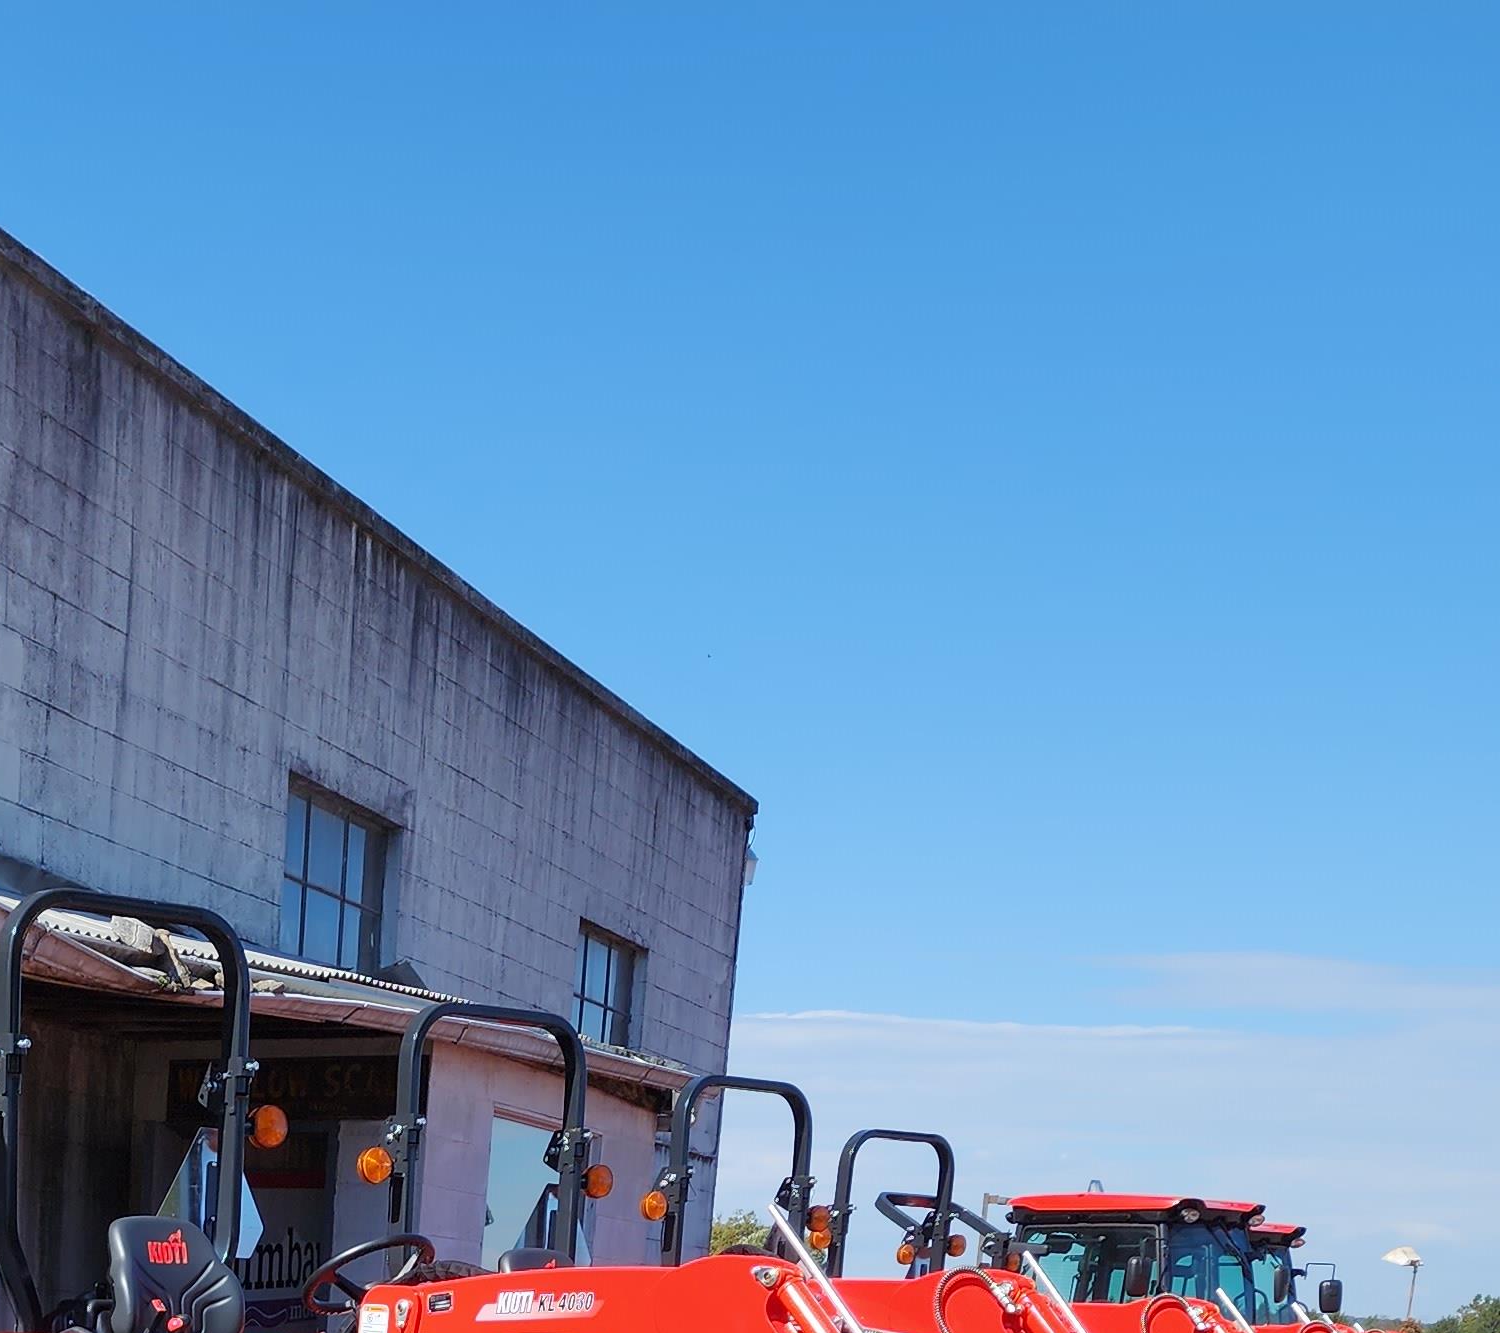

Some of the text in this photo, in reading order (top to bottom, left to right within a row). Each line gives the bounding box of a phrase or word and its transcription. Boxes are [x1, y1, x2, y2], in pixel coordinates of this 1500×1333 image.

[147, 1240, 188, 1264] KIOTI
[496, 1290, 594, 1314] KIOTI KL 4030
